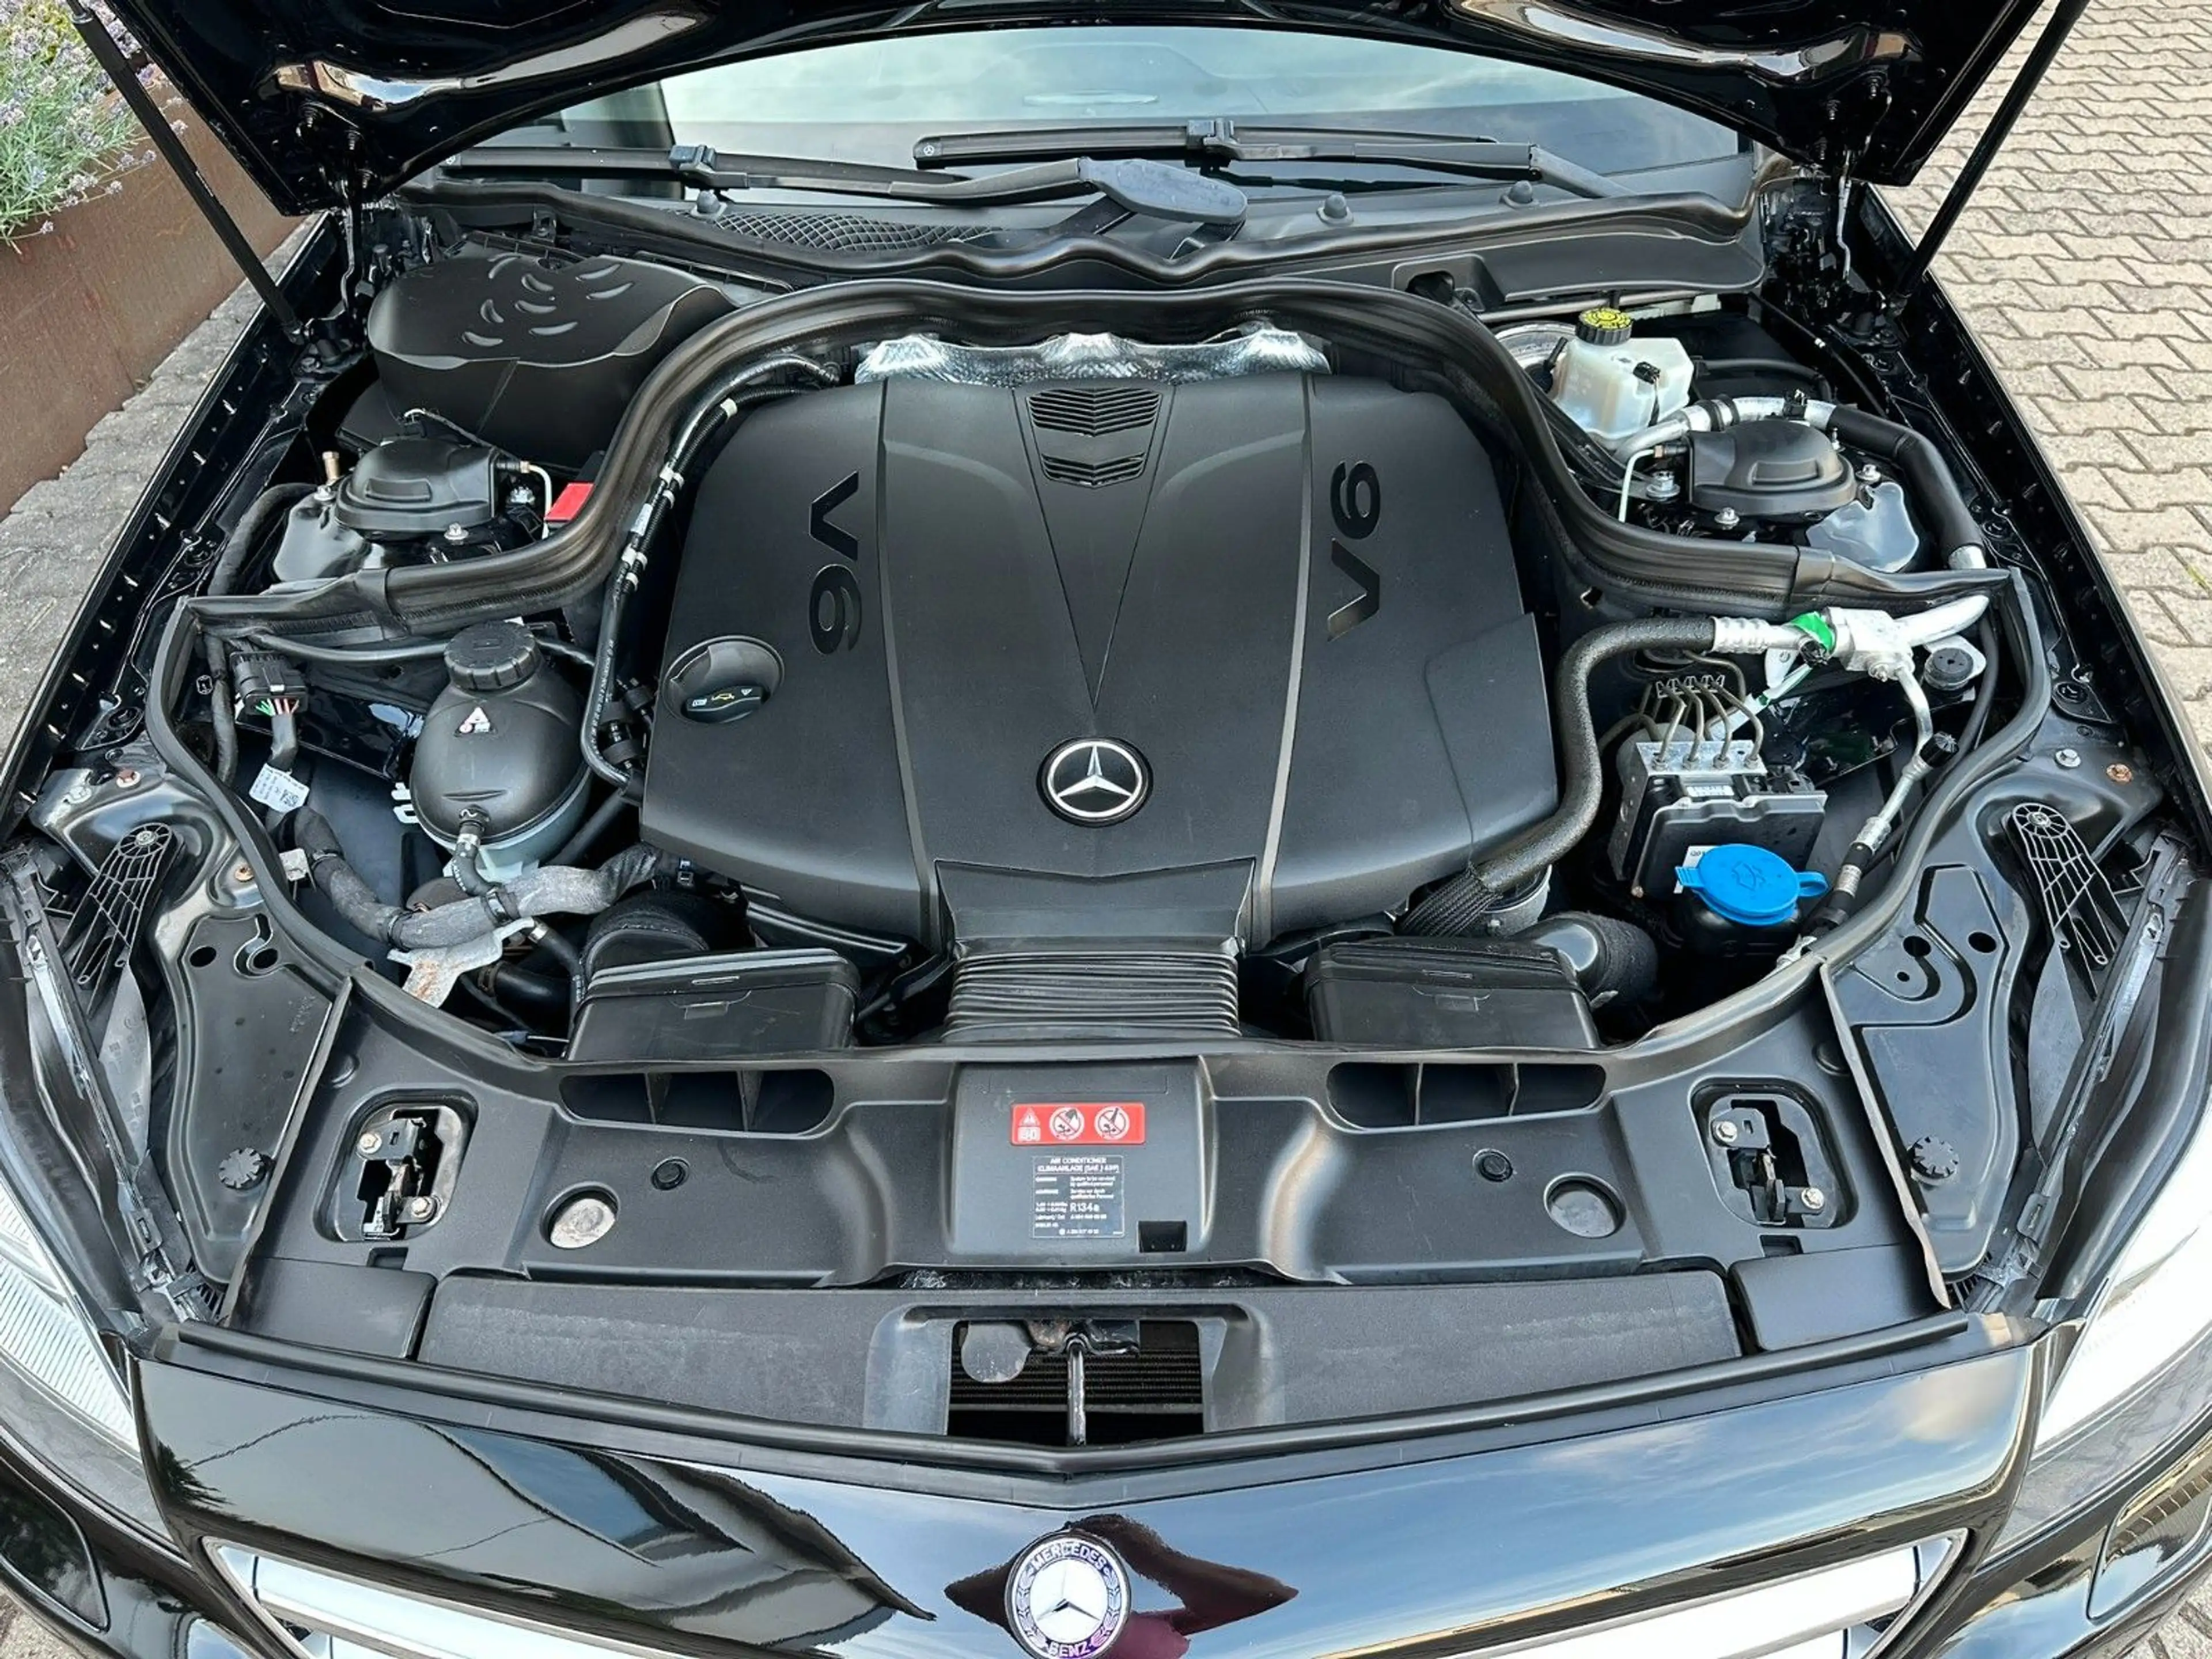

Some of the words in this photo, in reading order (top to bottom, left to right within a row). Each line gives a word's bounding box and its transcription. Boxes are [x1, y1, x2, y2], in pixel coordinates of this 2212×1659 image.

[809, 470, 862, 655] V6
[1327, 461, 1381, 642] V6
[1031, 1541, 1107, 1570] MERCEDES
[1048, 1641, 1092, 1658] BENZ
